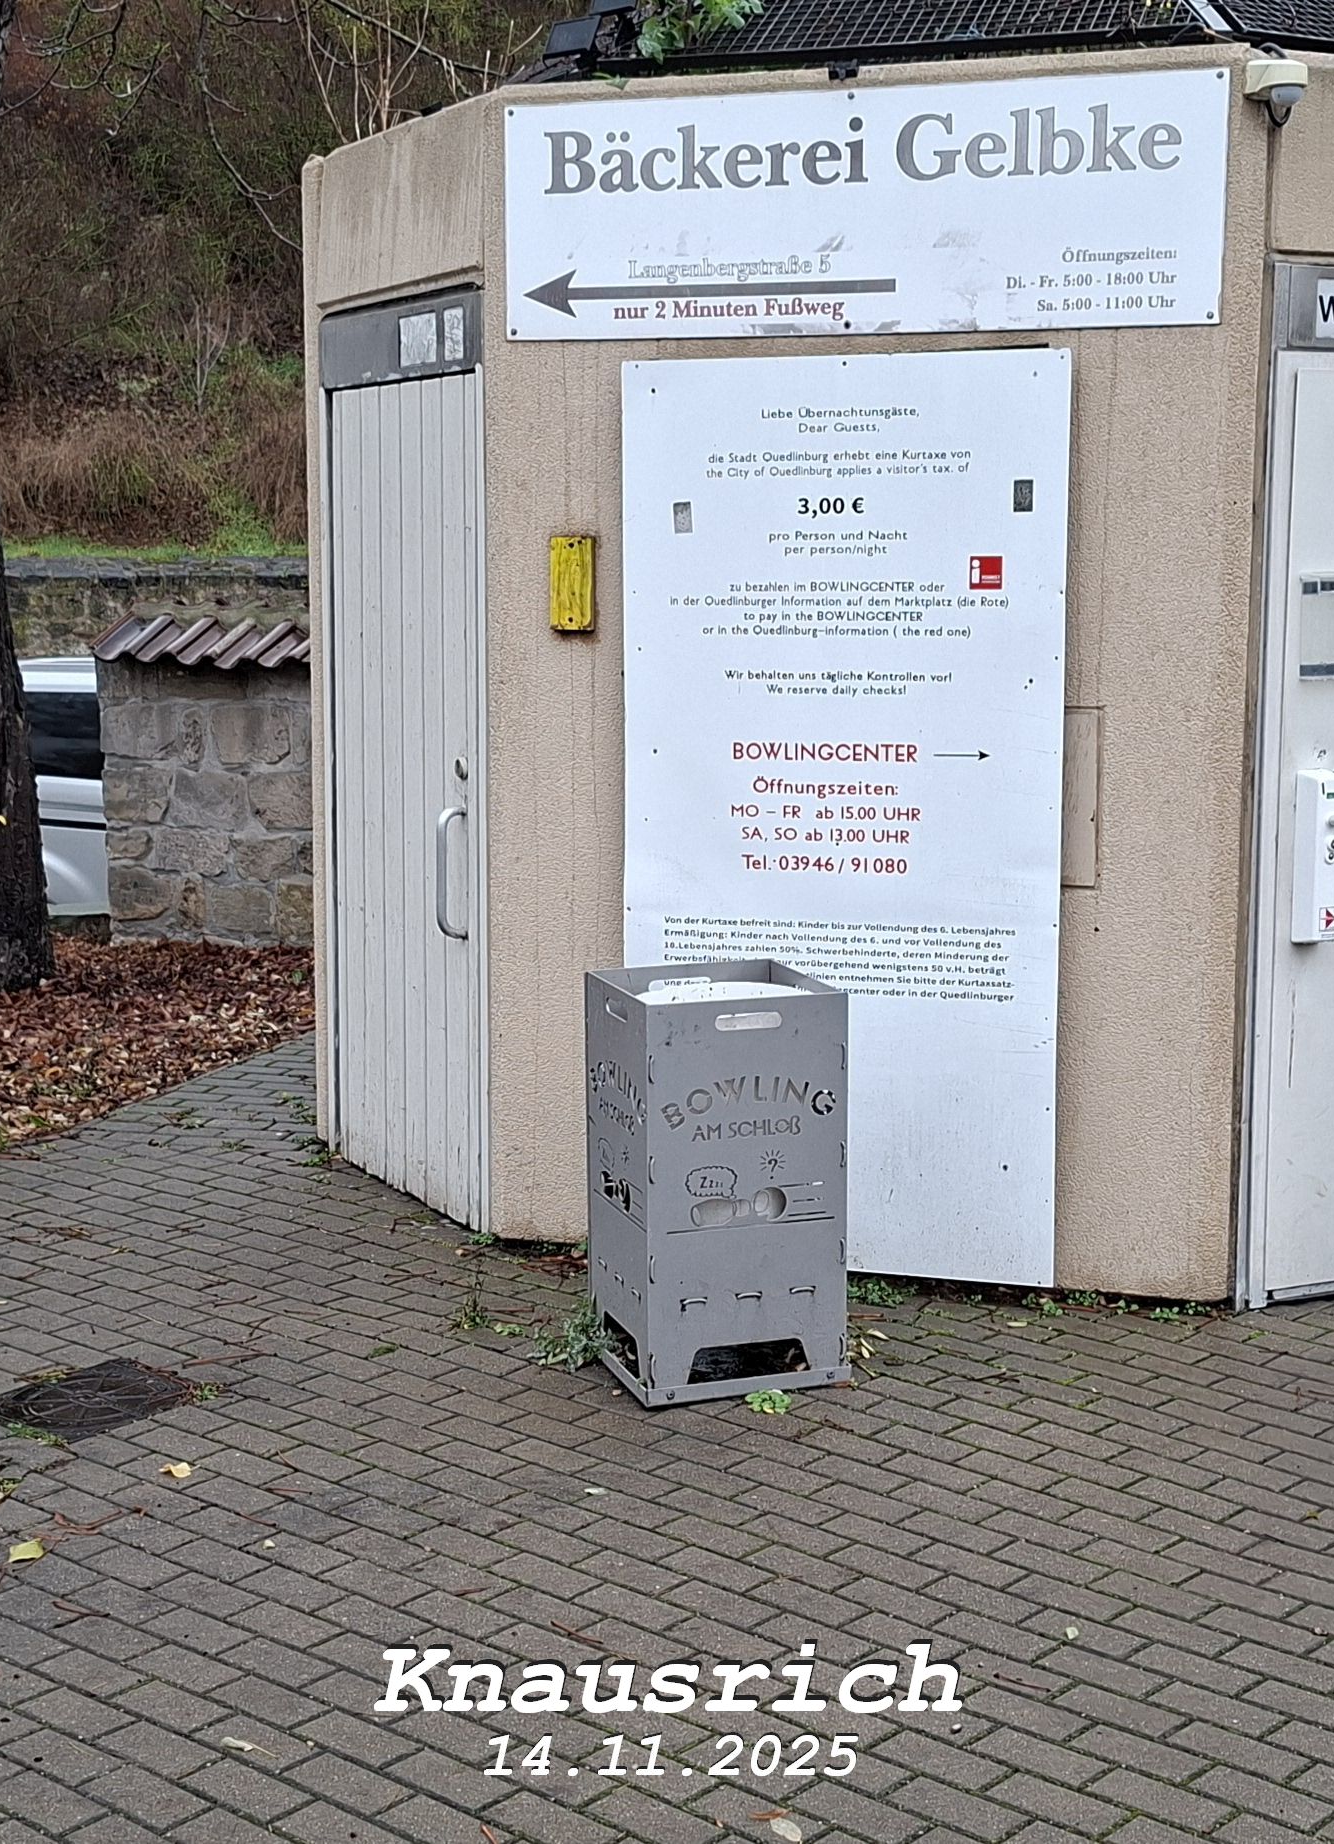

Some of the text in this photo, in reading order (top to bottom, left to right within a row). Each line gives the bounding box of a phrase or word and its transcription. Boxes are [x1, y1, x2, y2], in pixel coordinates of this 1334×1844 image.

[542, 103, 1182, 195] Bäckerei Gelbke
[1061, 246, 1177, 265] Öffnungszeiten:
[628, 254, 831, 284] Langenbergstraße 5
[1006, 271, 1177, 289] Di. Fr. 5:00 18:00 Uhr
[613, 297, 845, 321] nur 2 Minuten Fußweg
[1037, 295, 1176, 312] Sa. 5:00 11:00 Uhr
[761, 408, 793, 419] Liebe
[798, 422, 880, 433] Dear Guests,
[708, 449, 971, 463] die Stadt Quedlinburg erhebt eine Kurtaxe von
[706, 468, 723, 478] the
[727, 467, 749, 480] City
[754, 466, 765, 477] of
[836, 465, 872, 478] applies
[876, 467, 882, 475] a
[932, 464, 954, 474] tax.
[958, 462, 970, 473] of
[797, 497, 865, 519] 3,00 €
[769, 529, 908, 544] pro Person und Nacht
[785, 544, 887, 557] per person/night
[729, 581, 945, 592] zu bezahlen im BOWLINGCENTER oder
[670, 596, 679, 606] in
[683, 596, 700, 606] der
[781, 596, 842, 606] Information
[846, 596, 863, 607] auf
[867, 596, 891, 607] dem
[894, 596, 952, 609] Marktplatz
[957, 596, 976, 610] (die
[981, 596, 1009, 609] Rote)
[744, 611, 924, 623] to pay in the BOWLINGCENTER
[702, 627, 714, 635] or
[718, 625, 727, 635] in
[731, 625, 749, 635] the
[902, 626, 920, 636] the
[924, 626, 943, 637] red
[947, 626, 971, 639] one)
[724, 670, 743, 680] Wir
[747, 670, 794, 680] behalten
[821, 670, 863, 682] tägliche
[867, 671, 925, 682] Kontrollen
[930, 672, 952, 682] vor!
[766, 684, 783, 694] We
[832, 685, 858, 697] daily
[862, 685, 907, 695] checks!
[732, 742, 918, 763] BOWLINGCENTER
[752, 775, 899, 799] Öffnungszeiten:
[731, 804, 921, 821] MO FR ab 15.00 UHR
[741, 826, 910, 844] SA, SO ab 13.00 UHR
[779, 855, 835, 872] 03946
[864, 923, 919, 934] Vollendung
[921, 925, 938, 933] des
[951, 926, 1016, 937] Lebensjahres
[730, 930, 763, 939] Kinder
[765, 932, 789, 941] nach
[791, 933, 848, 944] Vollendung
[850, 936, 867, 944] des
[882, 937, 901, 945] und
[923, 938, 981, 950] Vollendung
[983, 940, 1002, 949] des
[745, 944, 1010, 963] zahlen deren Minderung der
[872, 963, 1006, 976] wenigstens 50 beträgt
[896, 976, 956, 986] Sie bitte der
[882, 989, 1014, 1002] oder in der Quedlinburger
[659, 1075, 837, 1131] BOWLING
[691, 1120, 722, 1142] AM
